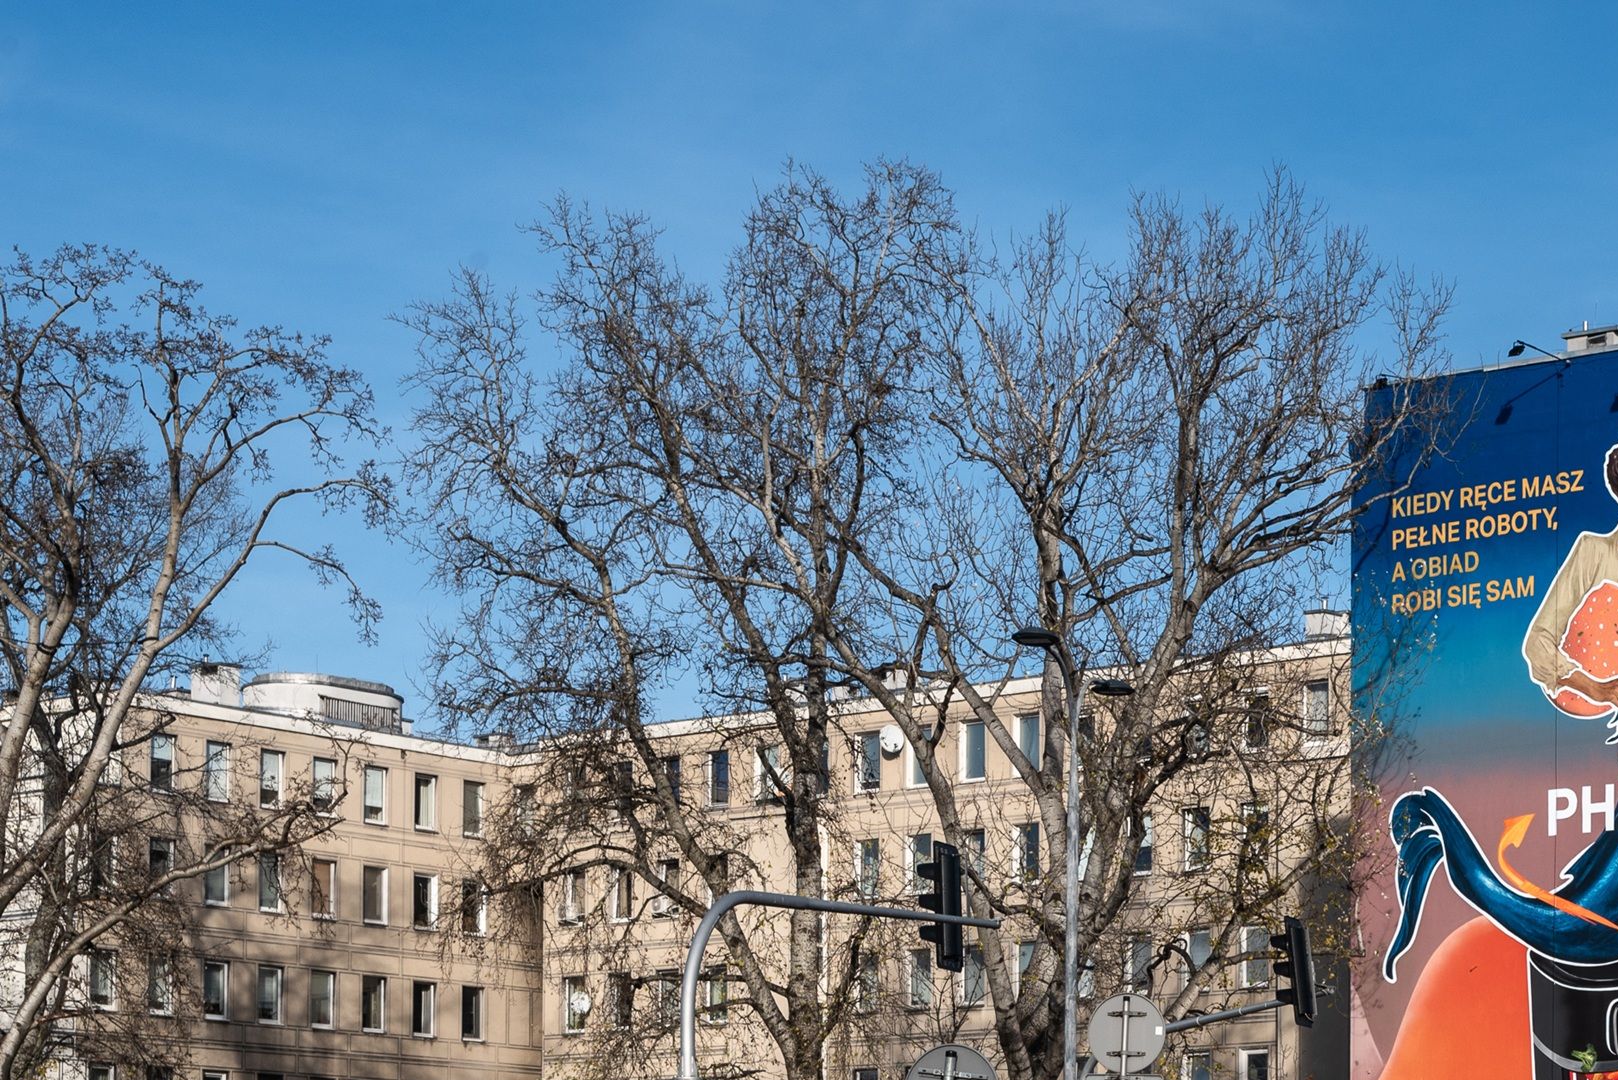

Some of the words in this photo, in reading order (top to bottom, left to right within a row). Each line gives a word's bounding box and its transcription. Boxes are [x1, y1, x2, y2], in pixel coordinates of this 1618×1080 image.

[1392, 489, 1455, 518] KIEDY
[1459, 480, 1516, 511] RĘCE
[1521, 470, 1584, 498] MASZ
[1392, 521, 1460, 550] PEŁNE
[1465, 507, 1558, 540] ROBOTY,
[1391, 562, 1406, 582] A
[1411, 551, 1480, 580] OBIAD
[1391, 588, 1442, 615] ROBI
[1447, 583, 1481, 609] SIĘ
[1486, 575, 1535, 602] SAM
